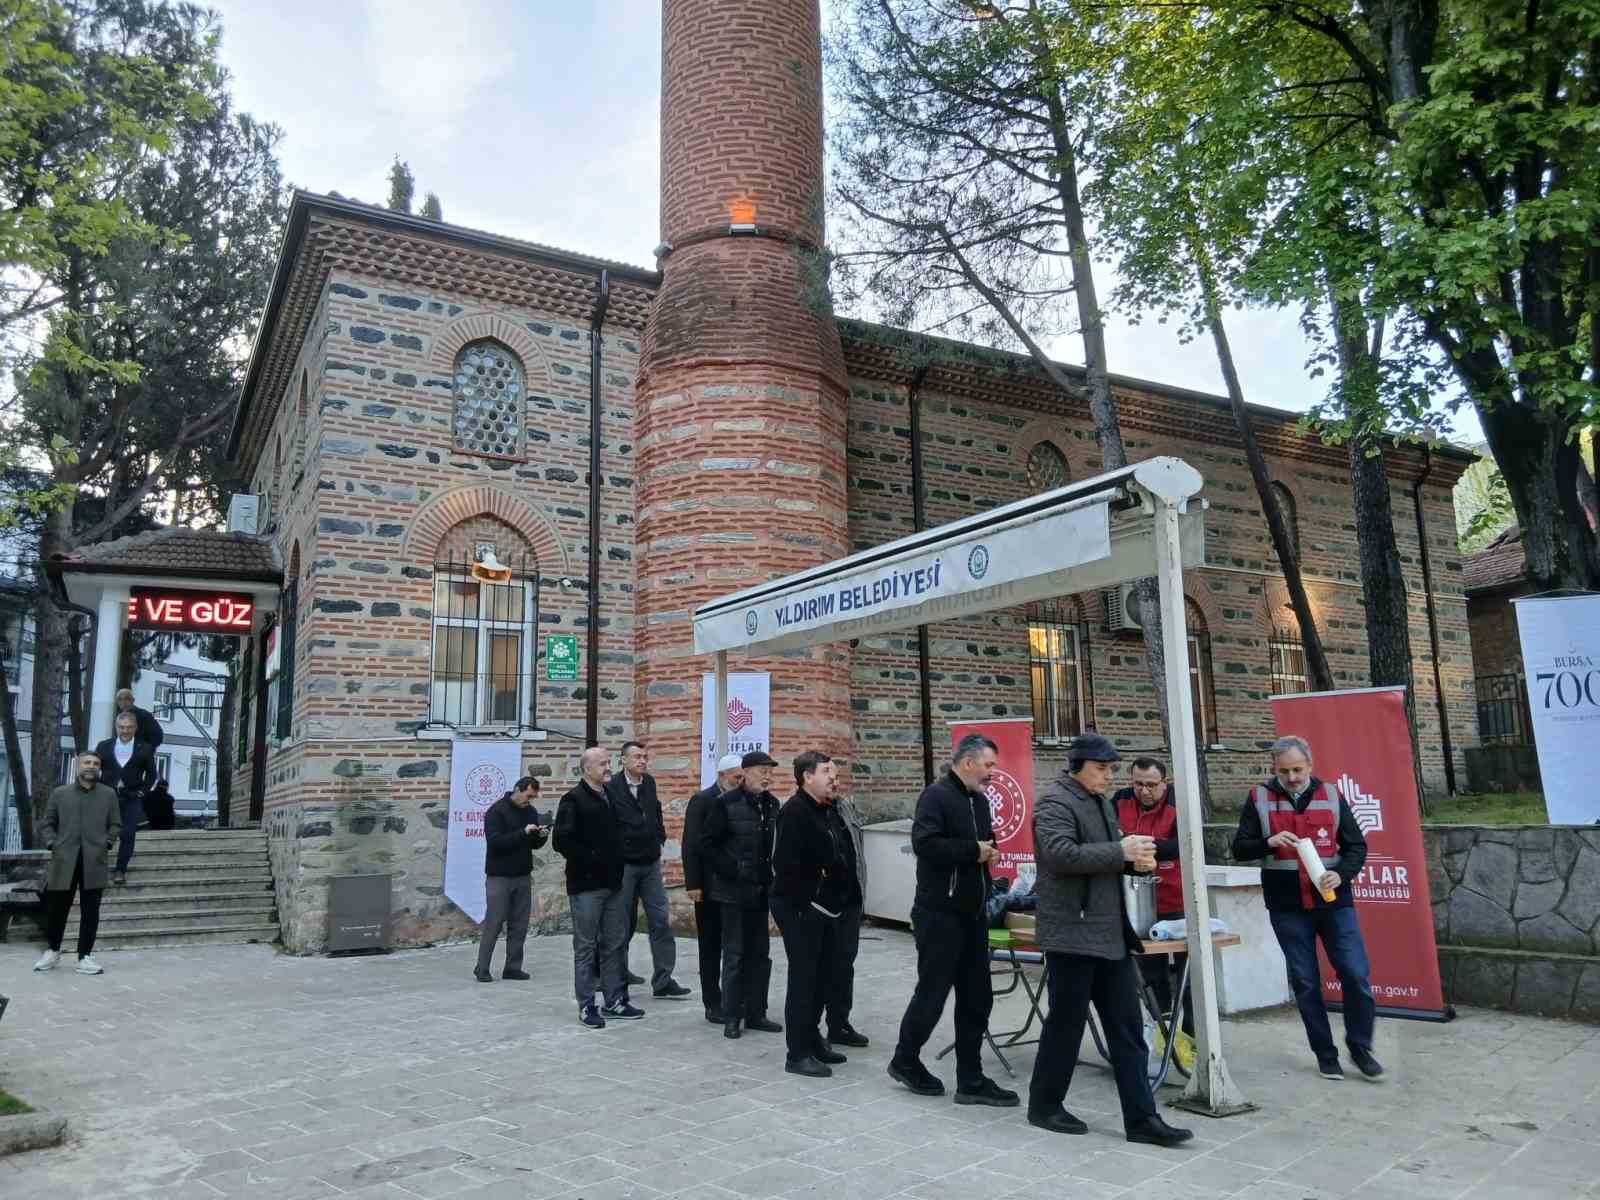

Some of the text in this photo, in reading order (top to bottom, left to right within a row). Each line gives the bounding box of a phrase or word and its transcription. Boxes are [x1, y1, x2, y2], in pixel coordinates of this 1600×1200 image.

[775, 593, 834, 627] YILDIRIM
[839, 558, 941, 612] BELEDİYESİ
[144, 598, 184, 622] VE
[190, 598, 252, 626] GÜZ
[1536, 670, 1600, 709] 700
[708, 742, 762, 753] VIFLAR
[465, 828, 485, 838] BAKA
[1351, 865, 1409, 885] FLAR
